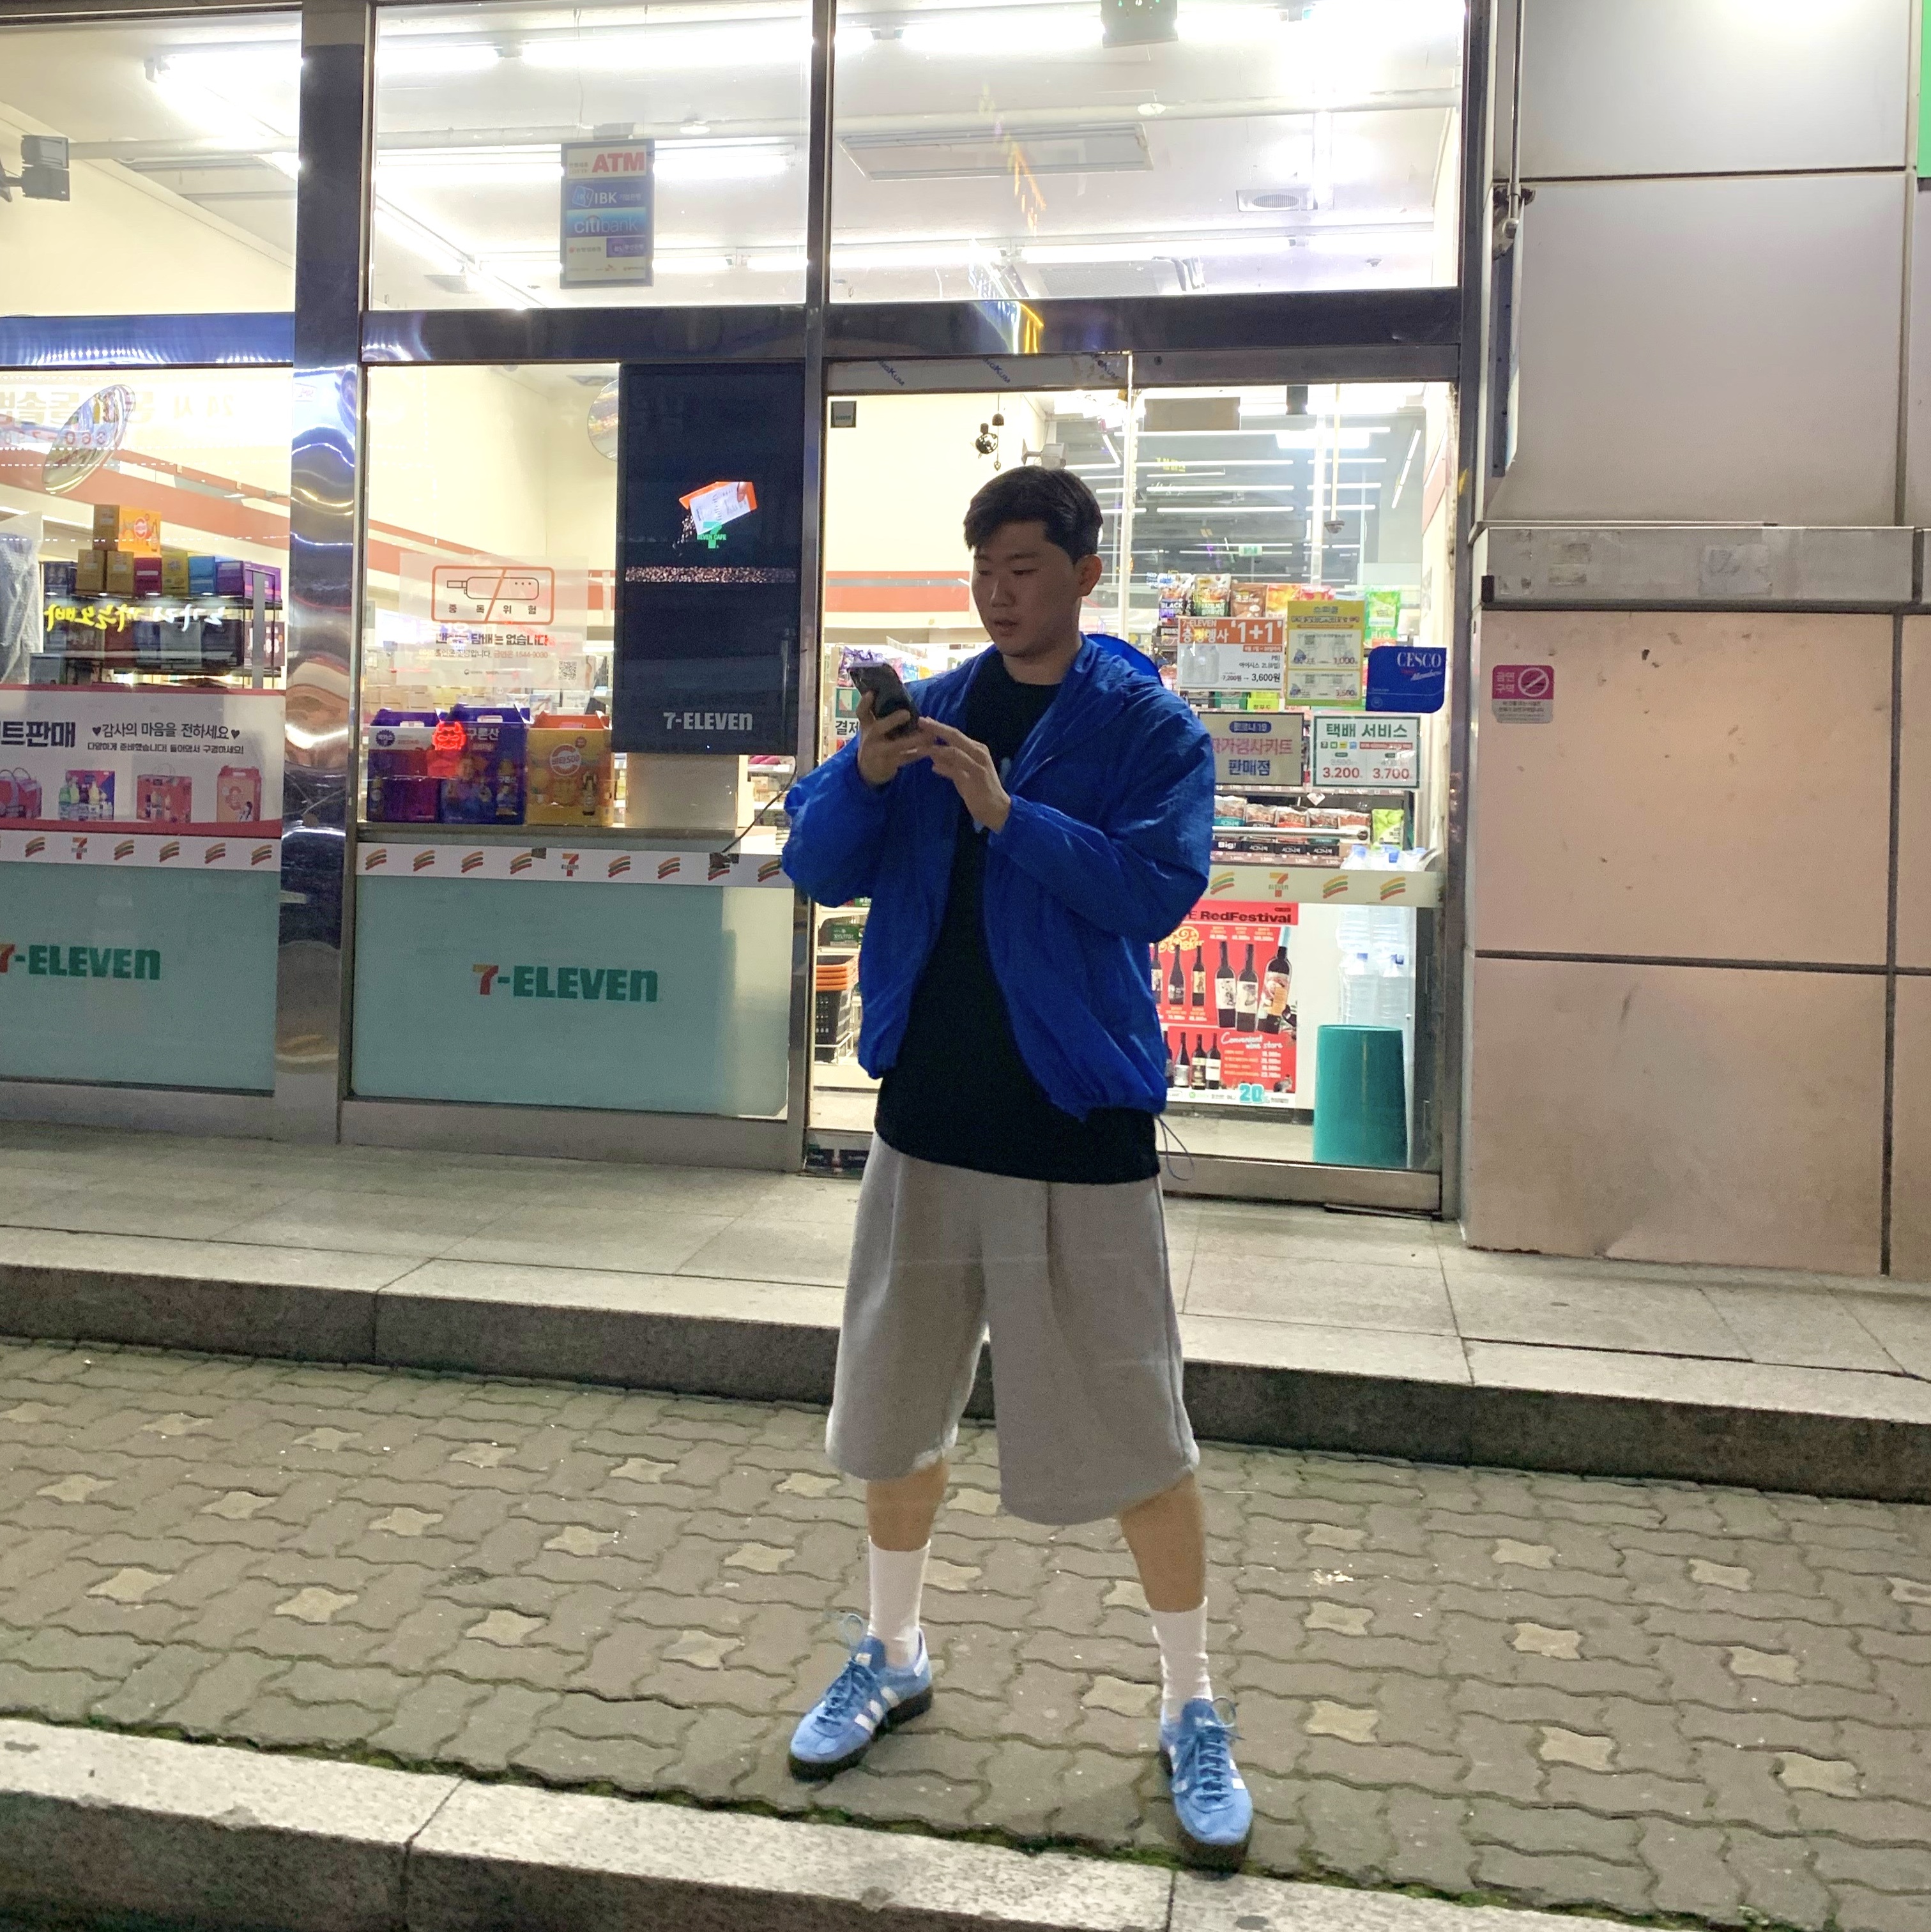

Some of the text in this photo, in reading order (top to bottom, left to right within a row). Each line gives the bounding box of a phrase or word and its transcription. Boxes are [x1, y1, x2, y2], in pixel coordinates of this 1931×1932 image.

[592, 152, 645, 172] ATM
[595, 192, 617, 204] IBK
[575, 217, 638, 234] citibank
[1397, 651, 1442, 668] CESCO
[1252, 673, 1280, 683] 3,600원
[1497, 672, 1515, 682] 금연
[1496, 684, 1515, 694] 구역
[0, 721, 75, 748] 트판매
[102, 722, 229, 740] 감사의 마음을 전하세요
[1326, 723, 1407, 738] 택배 서비스
[1229, 759, 1271, 776] 판매점
[1200, 911, 1291, 923] RedFestival
